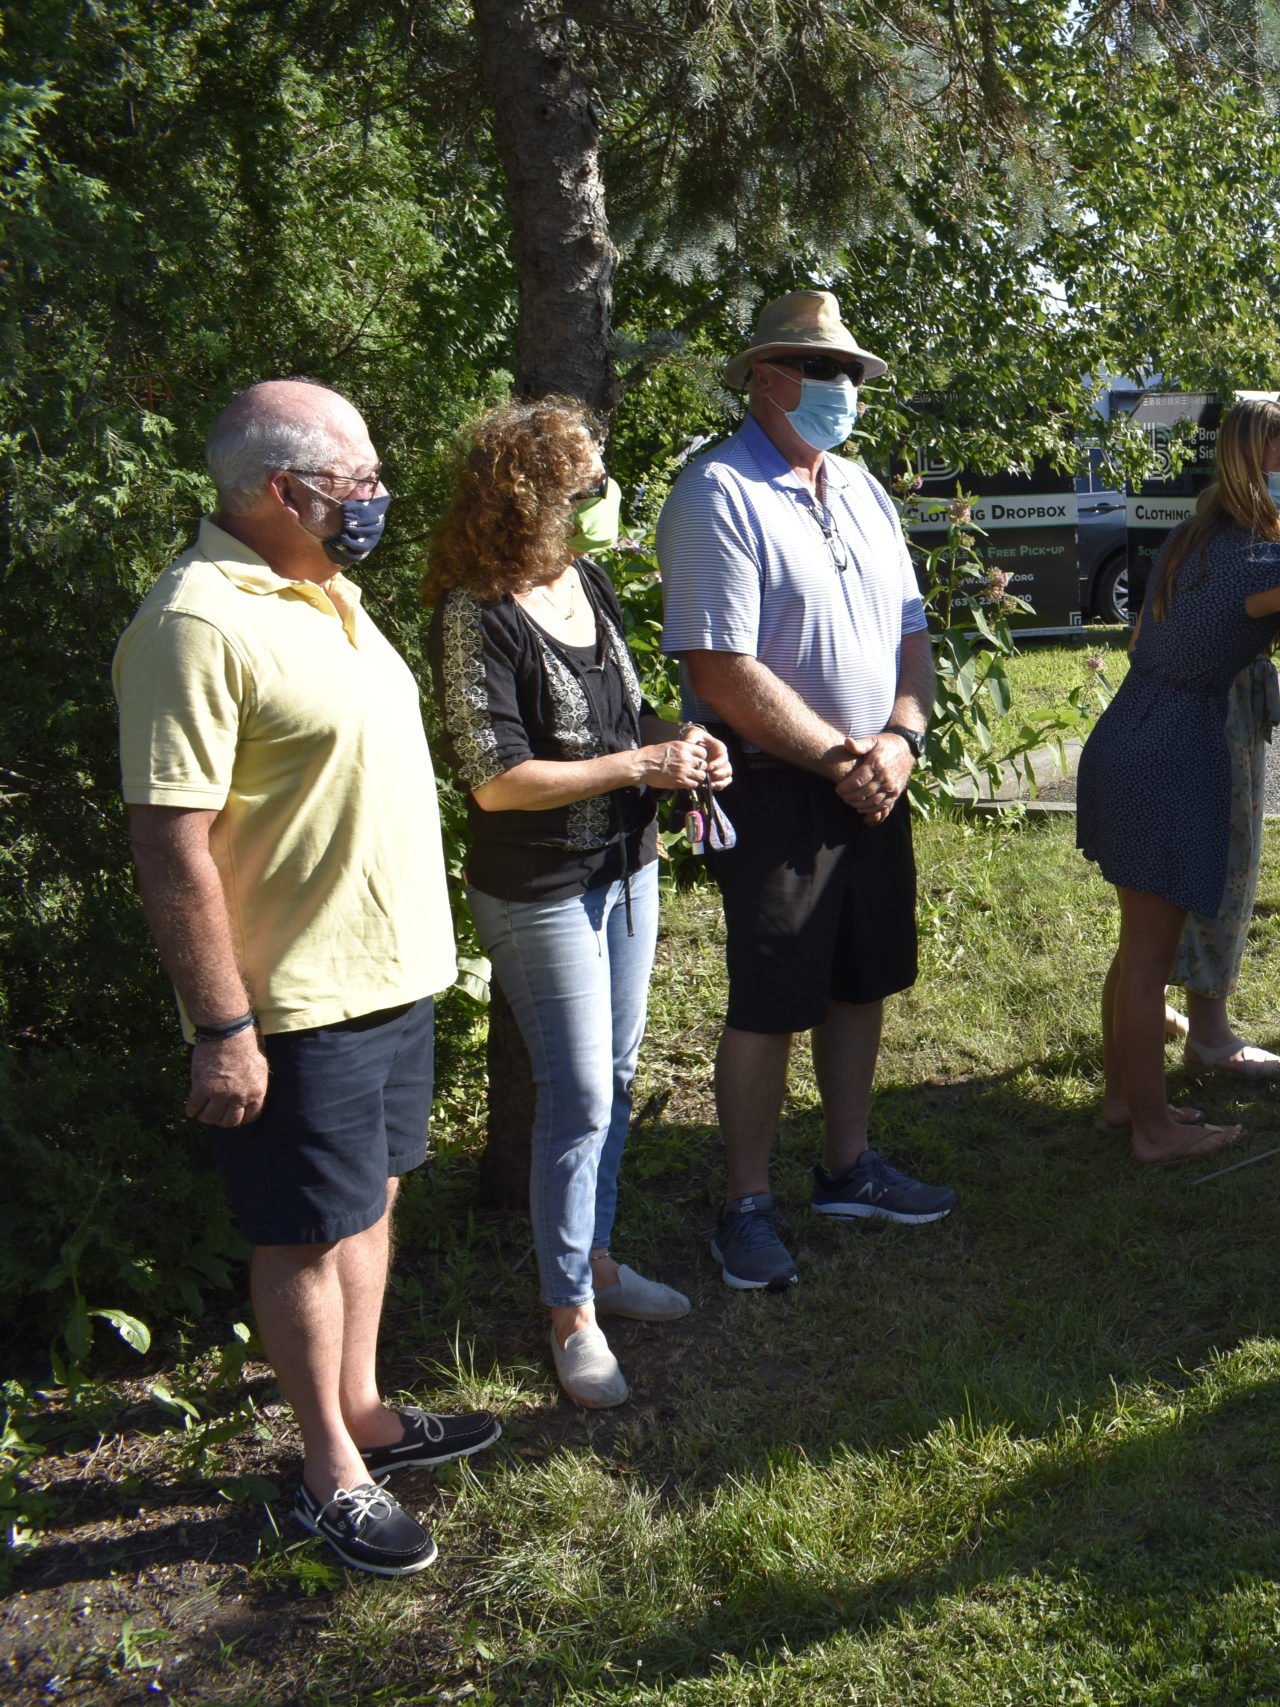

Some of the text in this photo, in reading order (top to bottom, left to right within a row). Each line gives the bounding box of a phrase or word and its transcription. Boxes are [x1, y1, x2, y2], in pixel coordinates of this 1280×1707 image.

[907, 504, 1067, 523] LOTNG DROPBOX
[911, 550, 969, 562] SCDULE
[988, 546, 1016, 558] FREE
[1020, 544, 1065, 557] PICK-UP
